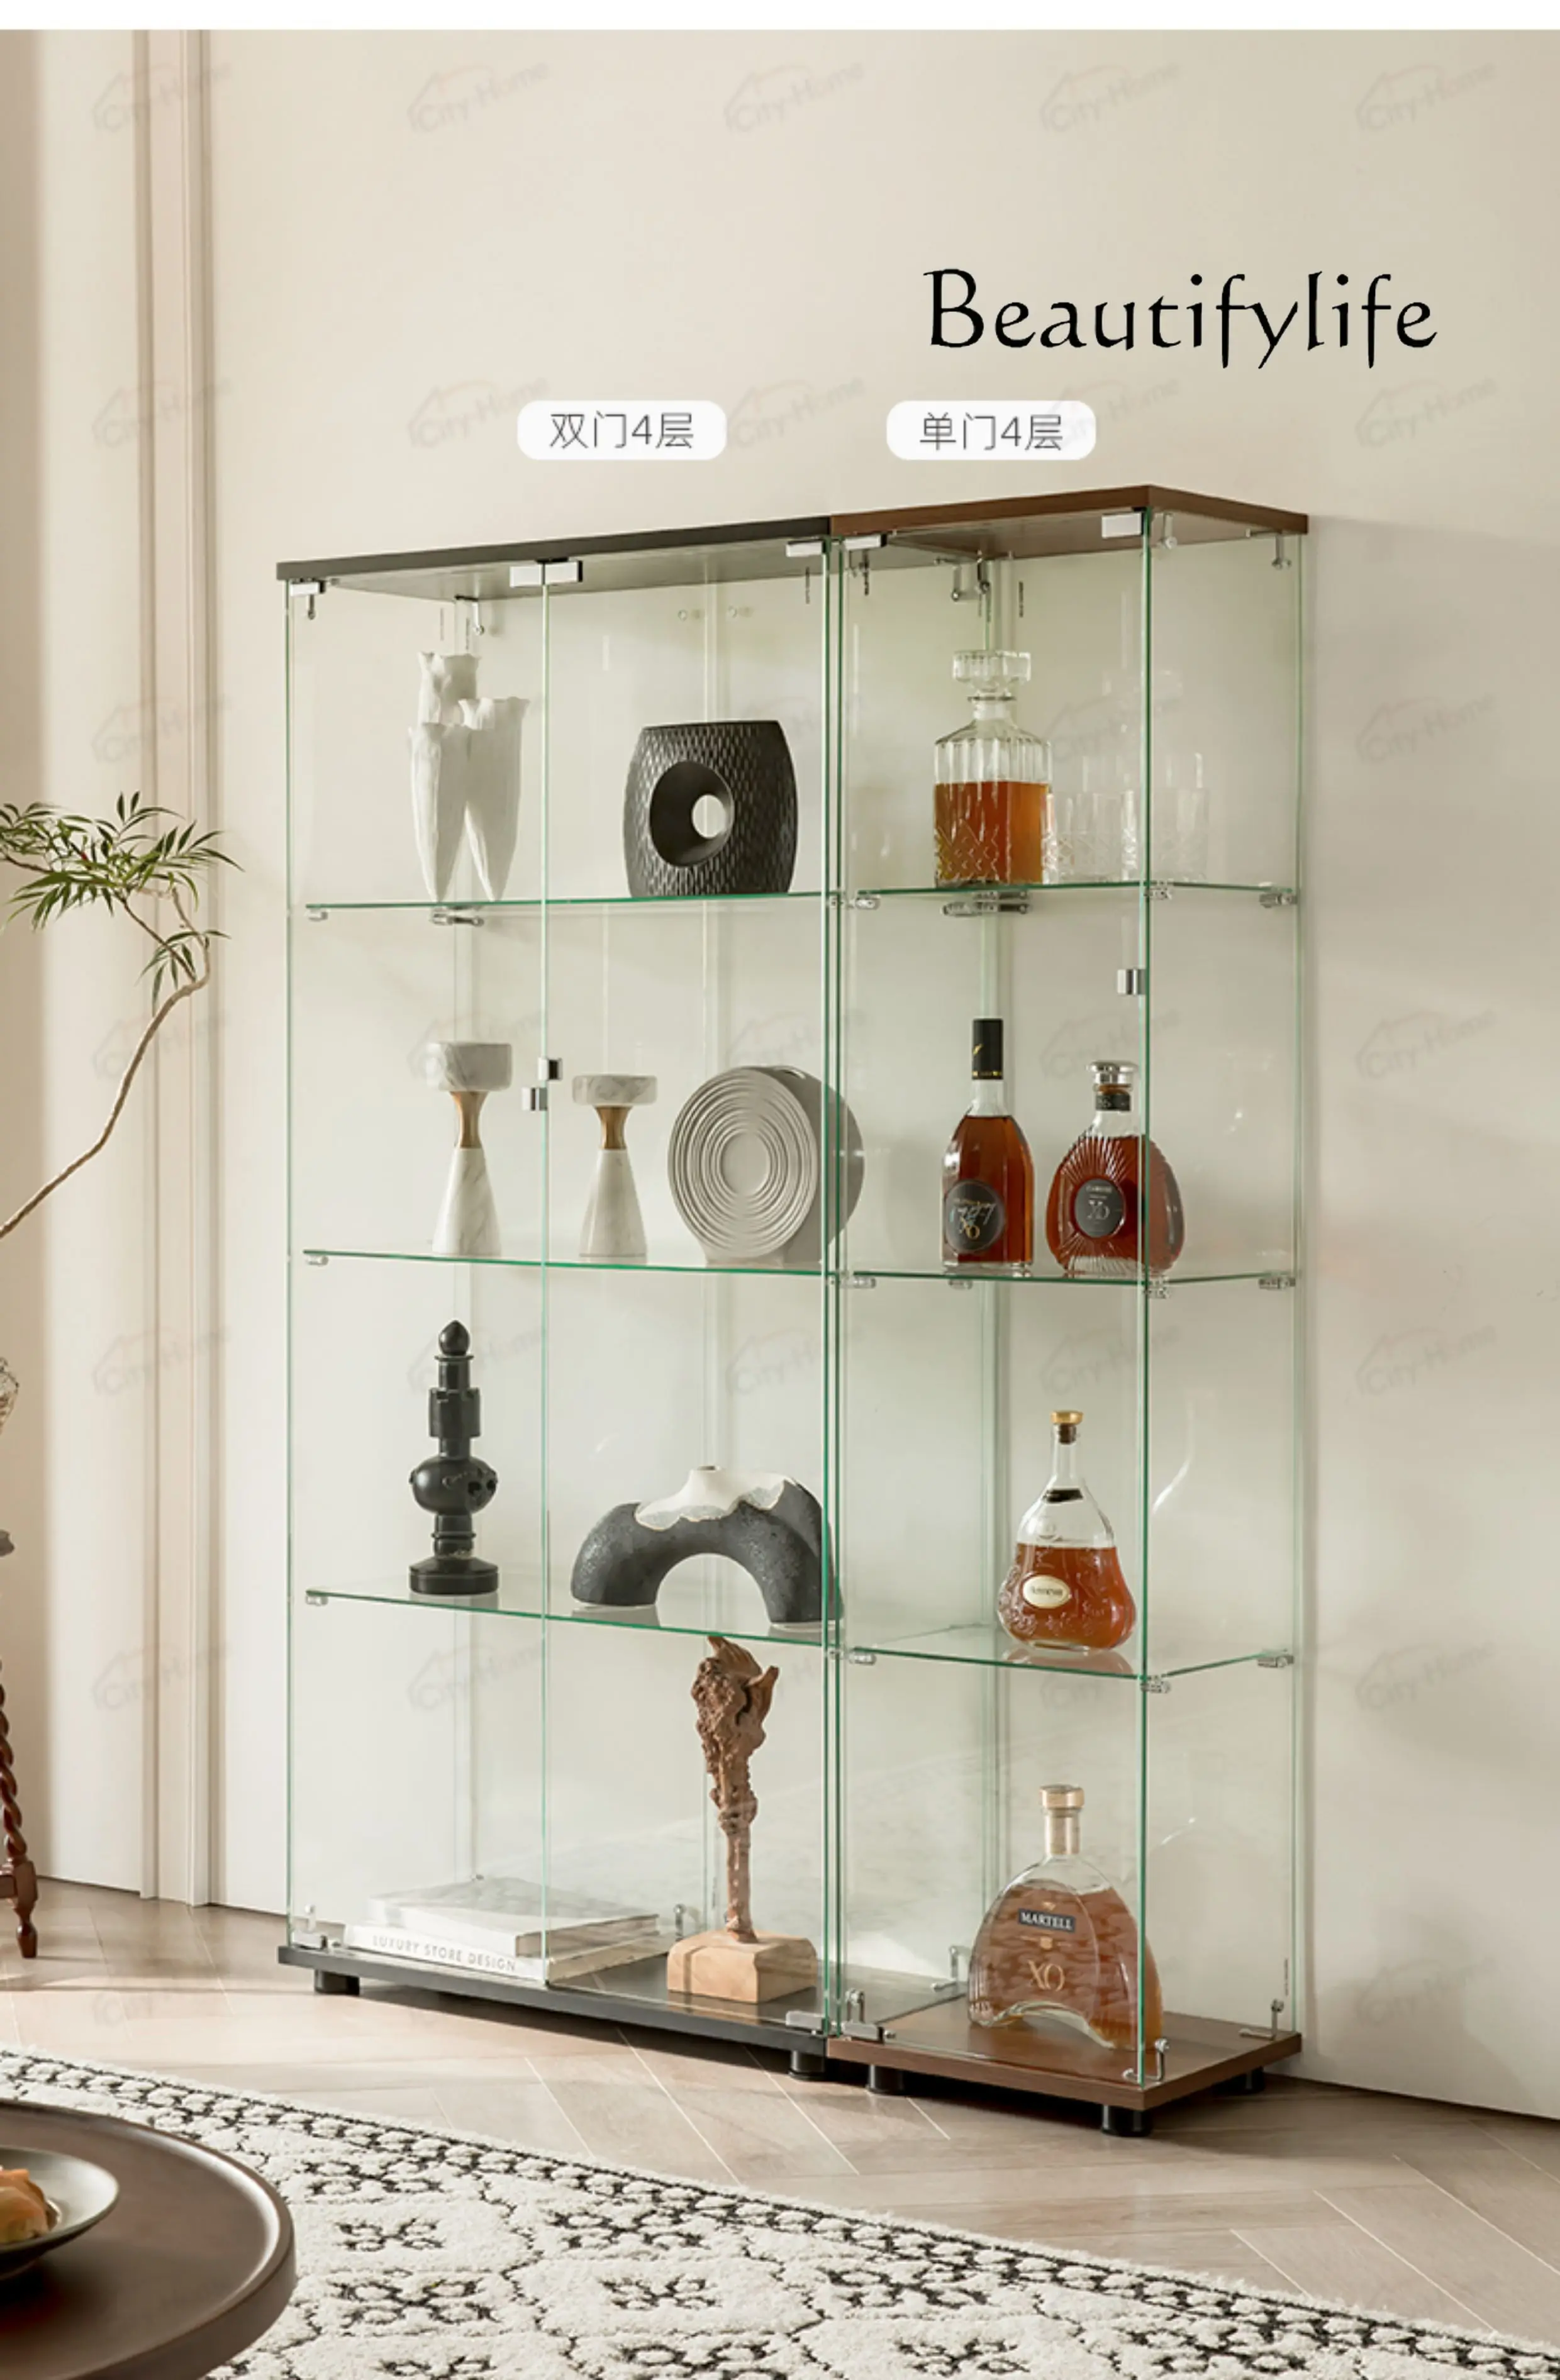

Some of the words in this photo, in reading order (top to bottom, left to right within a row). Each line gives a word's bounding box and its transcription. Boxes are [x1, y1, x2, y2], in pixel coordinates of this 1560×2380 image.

[1020, 1911, 1073, 1931] MARTELL
[372, 1935, 420, 1953] LUXURY
[424, 1943, 462, 1962] STORE
[468, 1953, 516, 1972] DESIGN
[1027, 1959, 1066, 1992] XO
